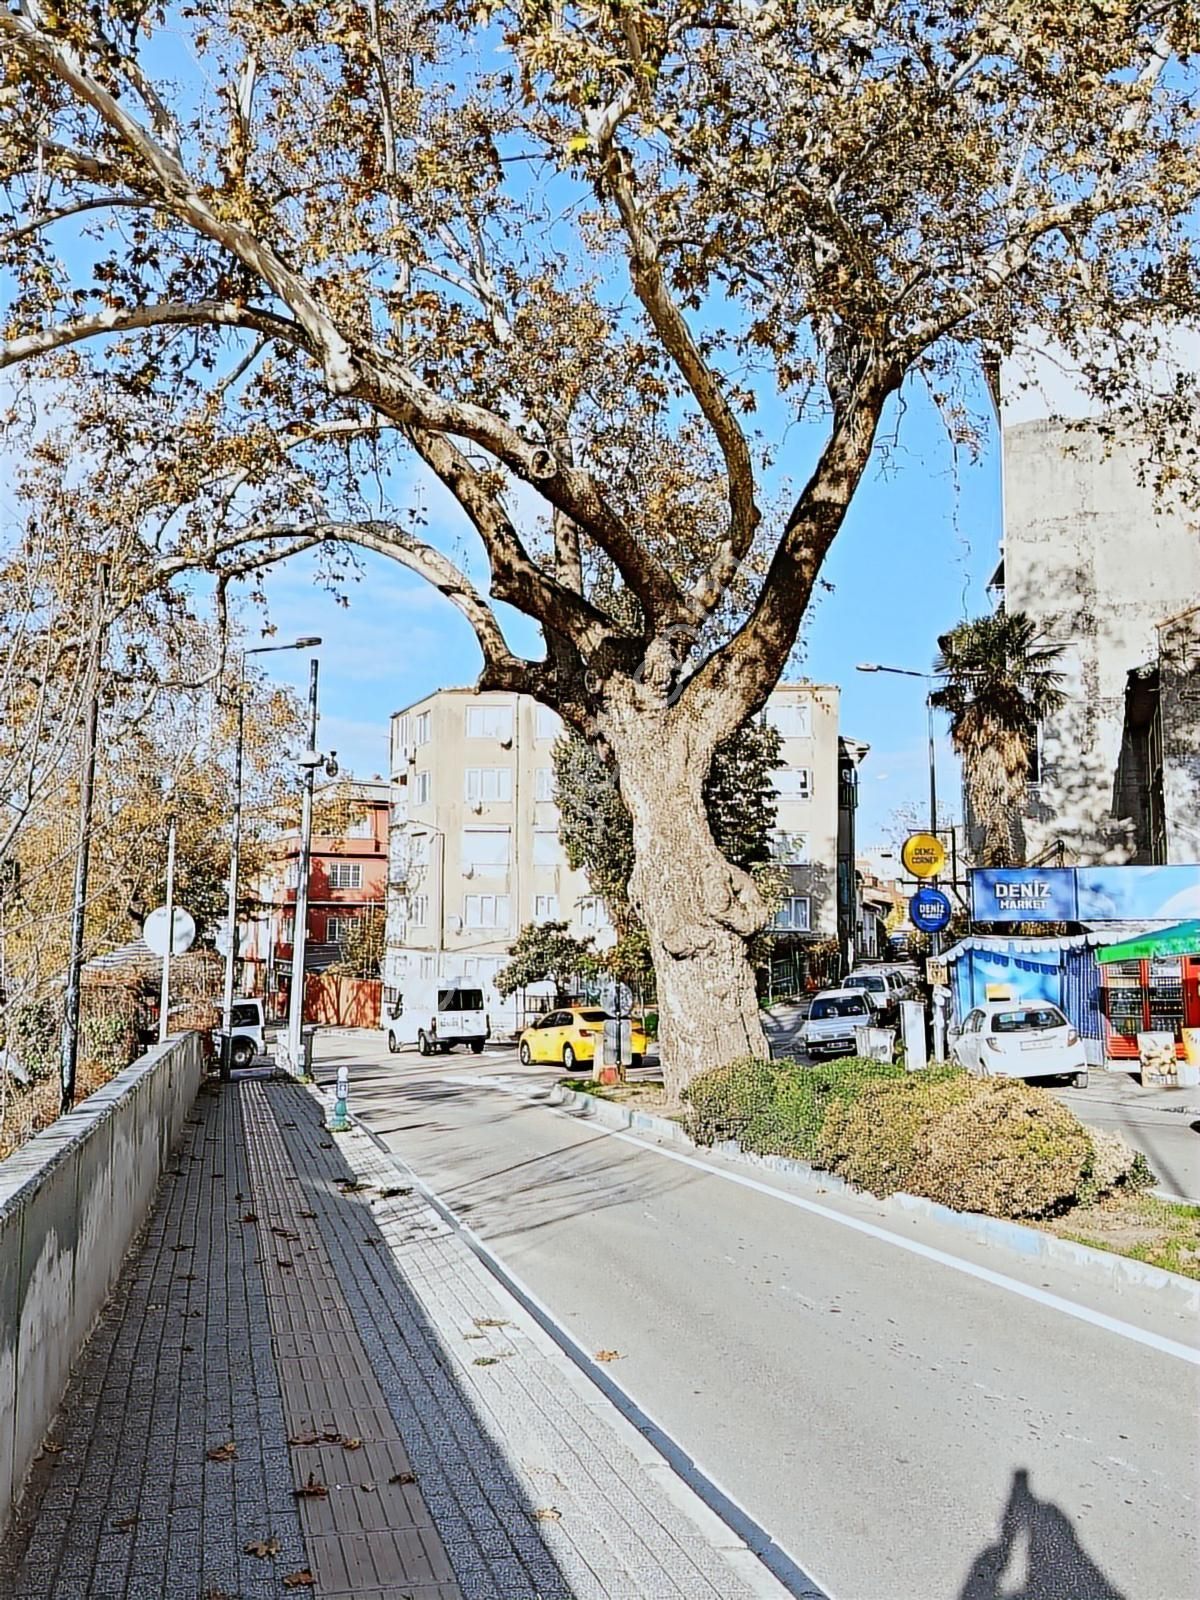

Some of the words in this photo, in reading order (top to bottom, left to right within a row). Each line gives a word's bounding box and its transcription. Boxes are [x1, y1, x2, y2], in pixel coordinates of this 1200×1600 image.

[995, 880, 1052, 897] DENİZ
[919, 902, 945, 913] DENİZ
[1000, 899, 1046, 909] MARKET
